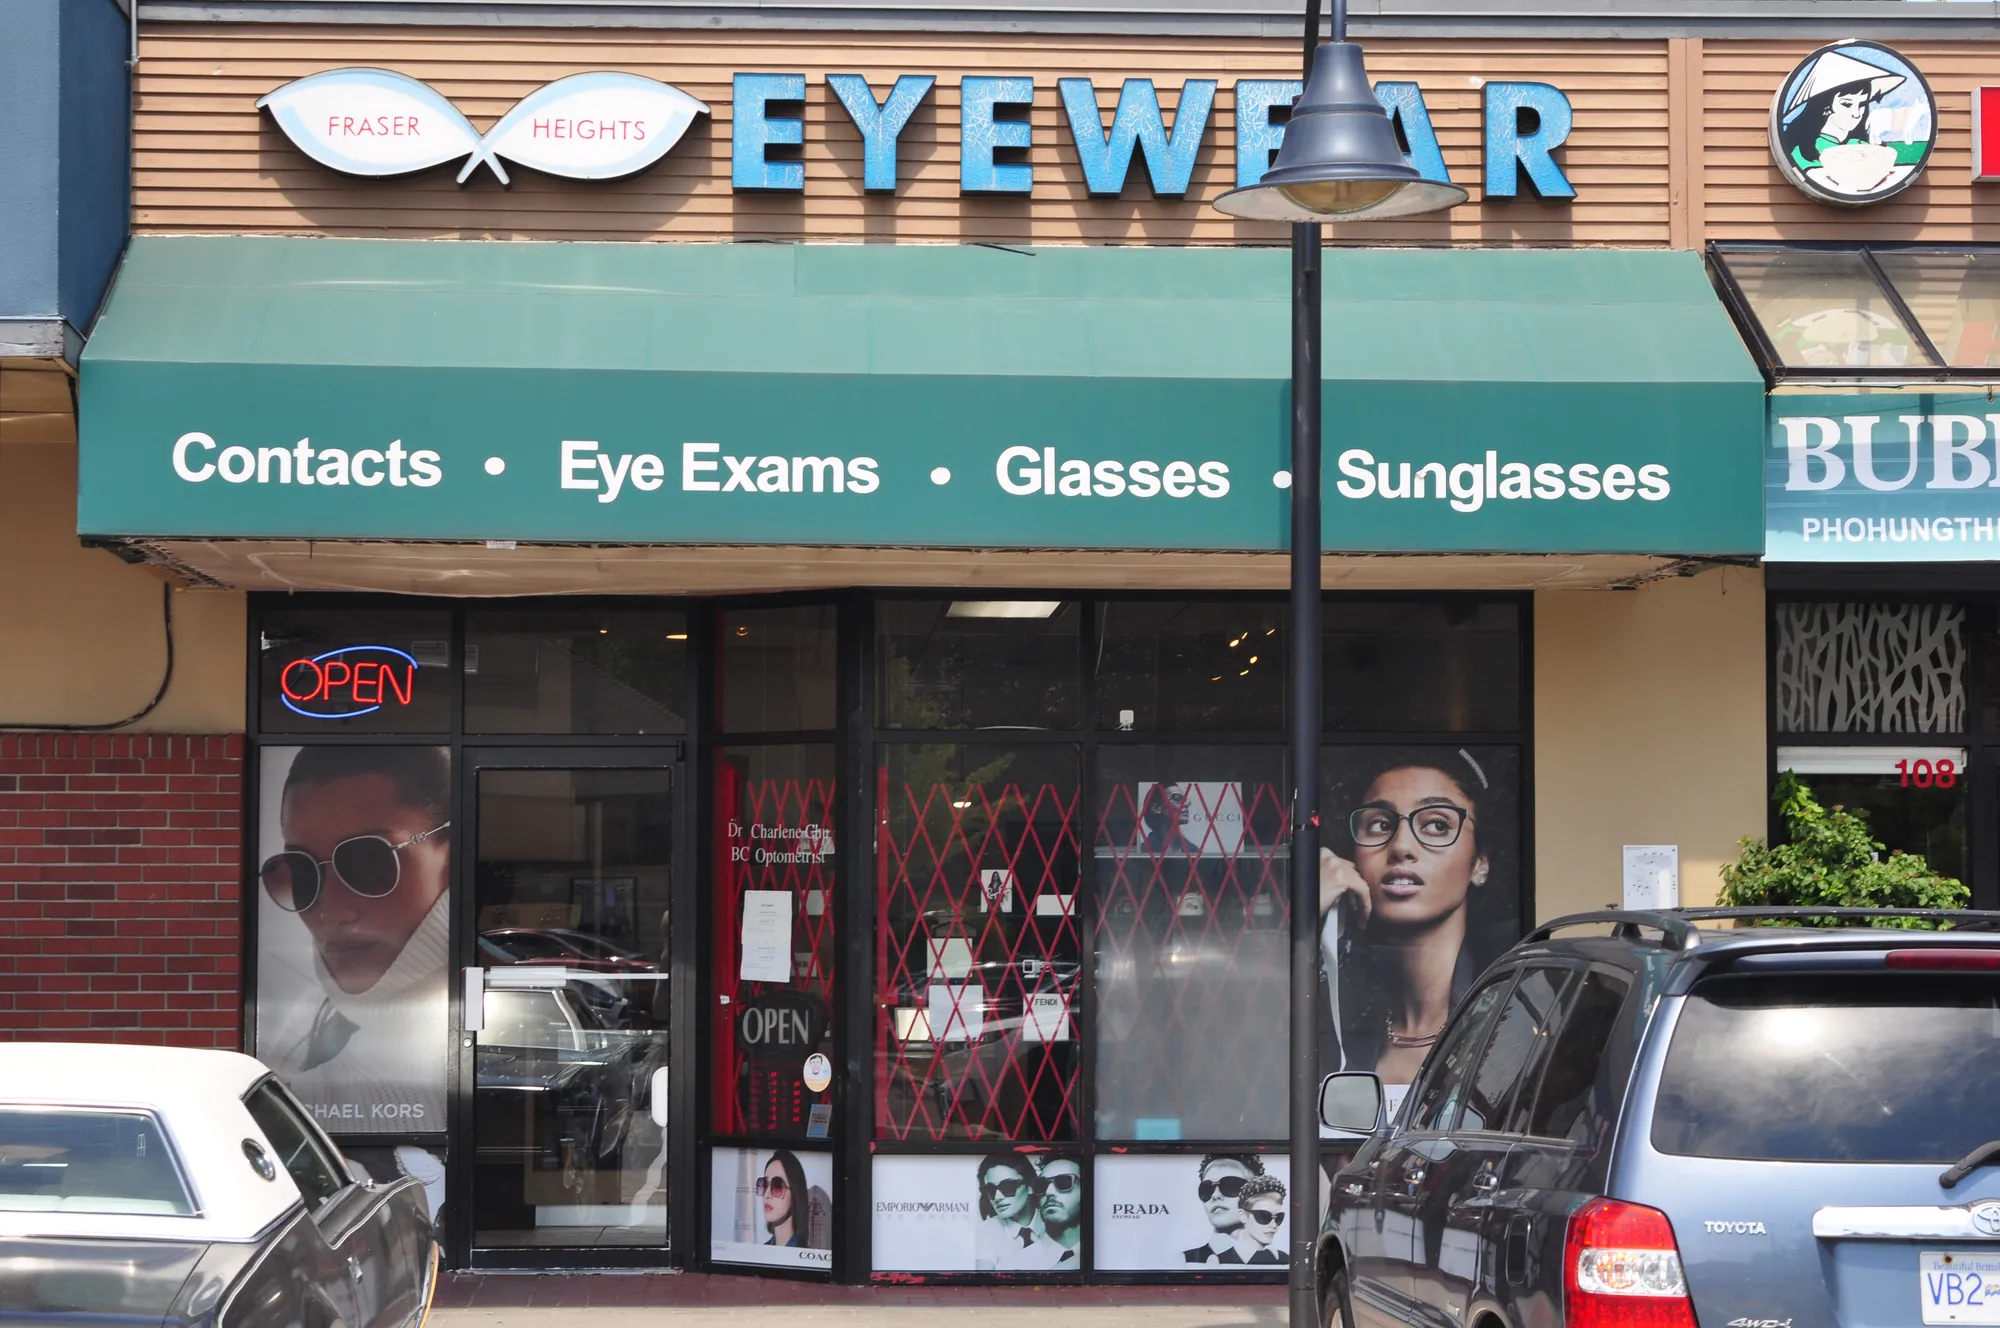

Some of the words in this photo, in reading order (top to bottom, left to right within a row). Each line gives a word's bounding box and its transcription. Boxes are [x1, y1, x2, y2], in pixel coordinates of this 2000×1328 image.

[328, 116, 420, 137] FRASER
[533, 118, 646, 141] HEIGHTS
[172, 431, 443, 487] Contacts
[1778, 414, 2000, 491] BUB
[560, 440, 664, 504] Eye
[682, 442, 880, 494] Exams
[995, 445, 1231, 498] Glasses
[1336, 448, 1671, 513] Sunglasses
[1802, 517, 2000, 543] PHOHUNGTH
[280, 658, 413, 705] OPEN
[1895, 759, 1957, 789] 108
[728, 822, 743, 838] Dr
[751, 824, 801, 839] Charlene
[731, 846, 750, 862] BC
[755, 848, 826, 867] Optometrist
[1035, 998, 1058, 1006] FENDI
[742, 1007, 809, 1044] OPEN
[371, 1103, 425, 1118] KORS
[876, 1202, 919, 1212] EMPORIO
[932, 1202, 969, 1212] ARMANI
[1112, 1203, 1170, 1215] PRADA
[1704, 1220, 1767, 1235] TOYOTA
[1927, 1272, 1984, 1305] VB2
